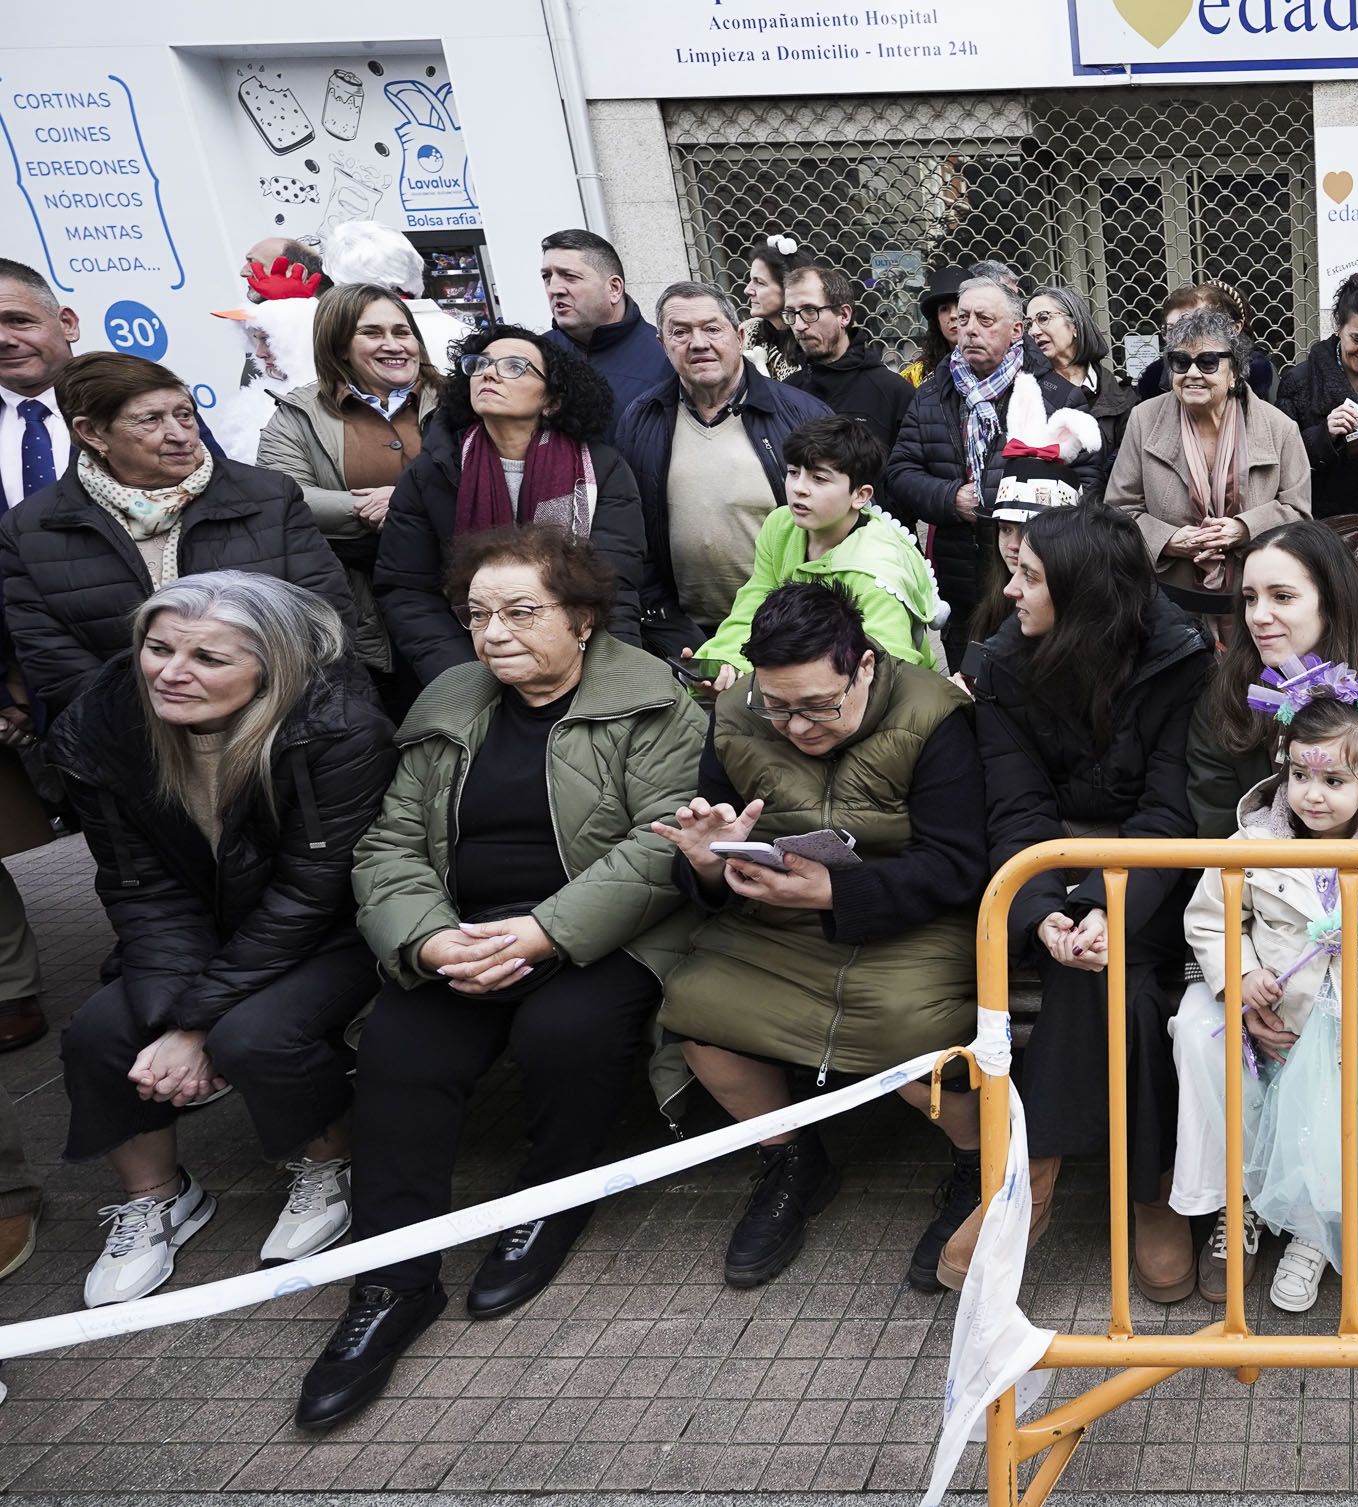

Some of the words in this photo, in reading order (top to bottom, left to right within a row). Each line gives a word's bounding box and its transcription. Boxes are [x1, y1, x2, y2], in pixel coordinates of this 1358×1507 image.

[709, 11, 859, 33] Acompañamiento
[865, 9, 938, 29] Hospital
[676, 47, 755, 66] Limpieza
[762, 51, 770, 61] a
[777, 43, 859, 61] Domicilio
[878, 42, 942, 58] Interna
[948, 41, 978, 56] 24h
[13, 91, 112, 110] CORTINAS
[34, 126, 111, 144] COJINES
[26, 158, 141, 177] EDREDONES
[407, 175, 461, 190] Lavalux
[43, 188, 144, 209] NÓRDICOS
[406, 213, 444, 228] Bolsa
[446, 212, 477, 226] rafia
[64, 224, 143, 241] MANTAS
[68, 256, 161, 273] COLADA...
